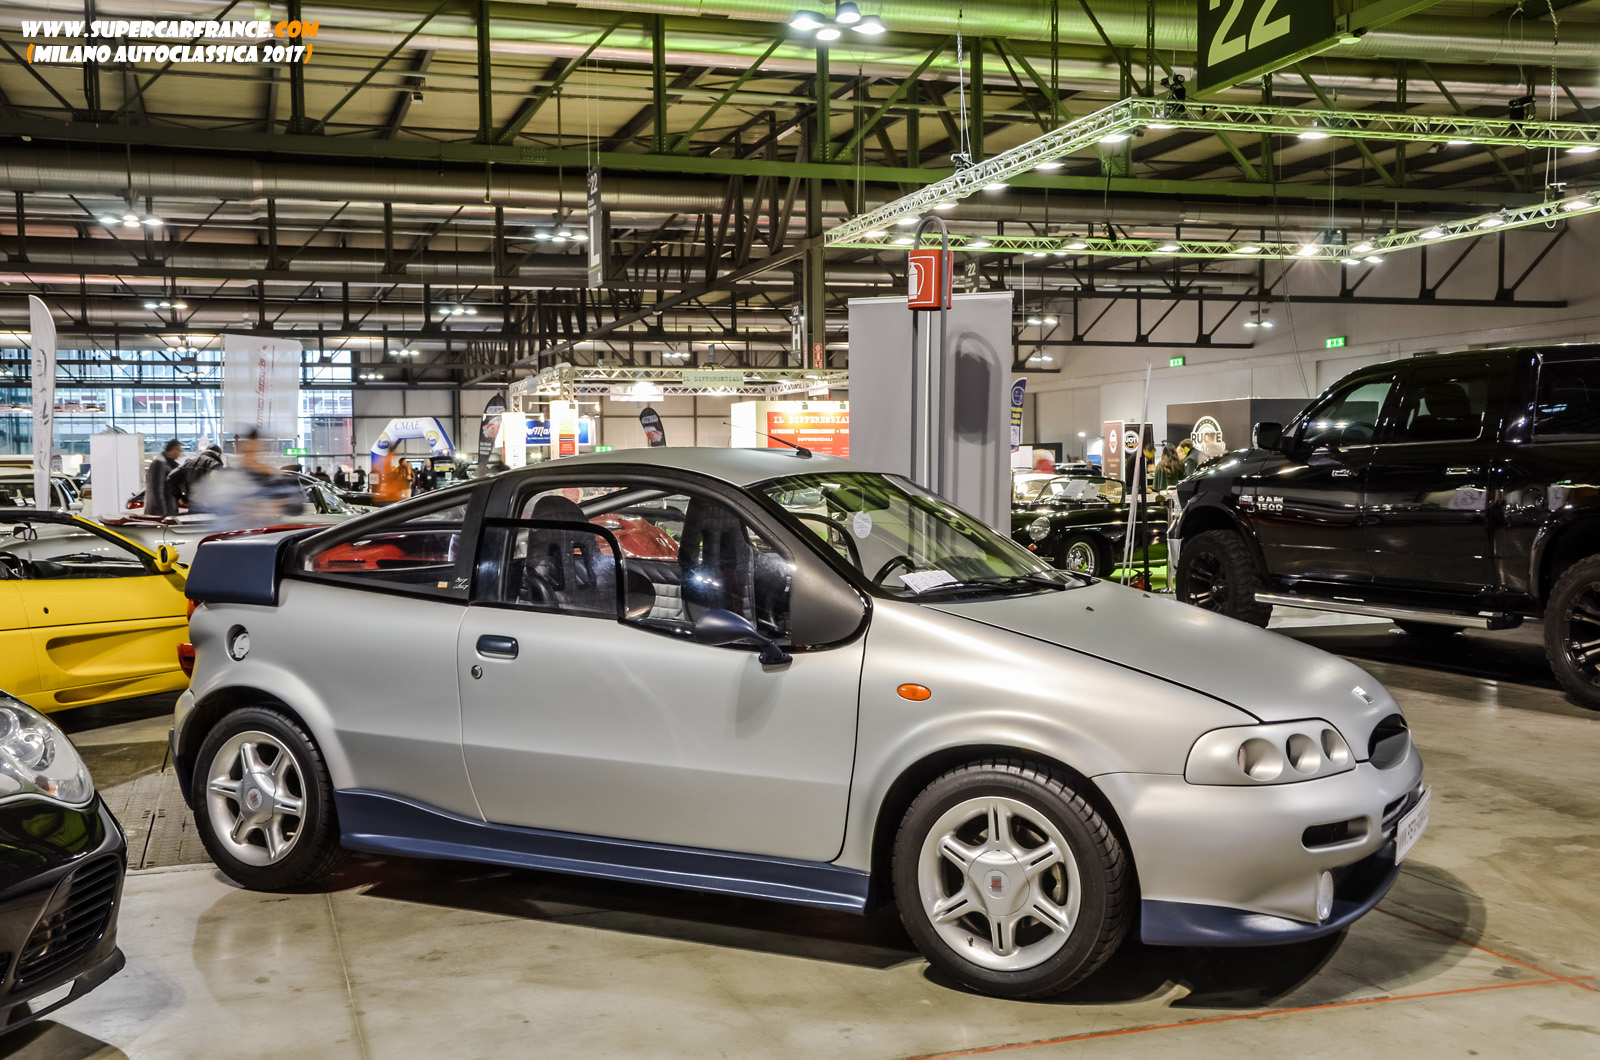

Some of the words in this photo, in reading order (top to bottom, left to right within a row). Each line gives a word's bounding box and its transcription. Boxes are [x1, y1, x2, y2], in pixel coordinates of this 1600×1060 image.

[590, 172, 598, 195] 22
[590, 216, 600, 267] L
[967, 262, 976, 277] 22
[792, 324, 800, 351] H
[394, 421, 420, 431] CMAE
[773, 416, 785, 424] IL
[1191, 432, 1222, 444] RUOTE
[1257, 495, 1284, 504] RAM
[1256, 503, 1284, 511] 1500
